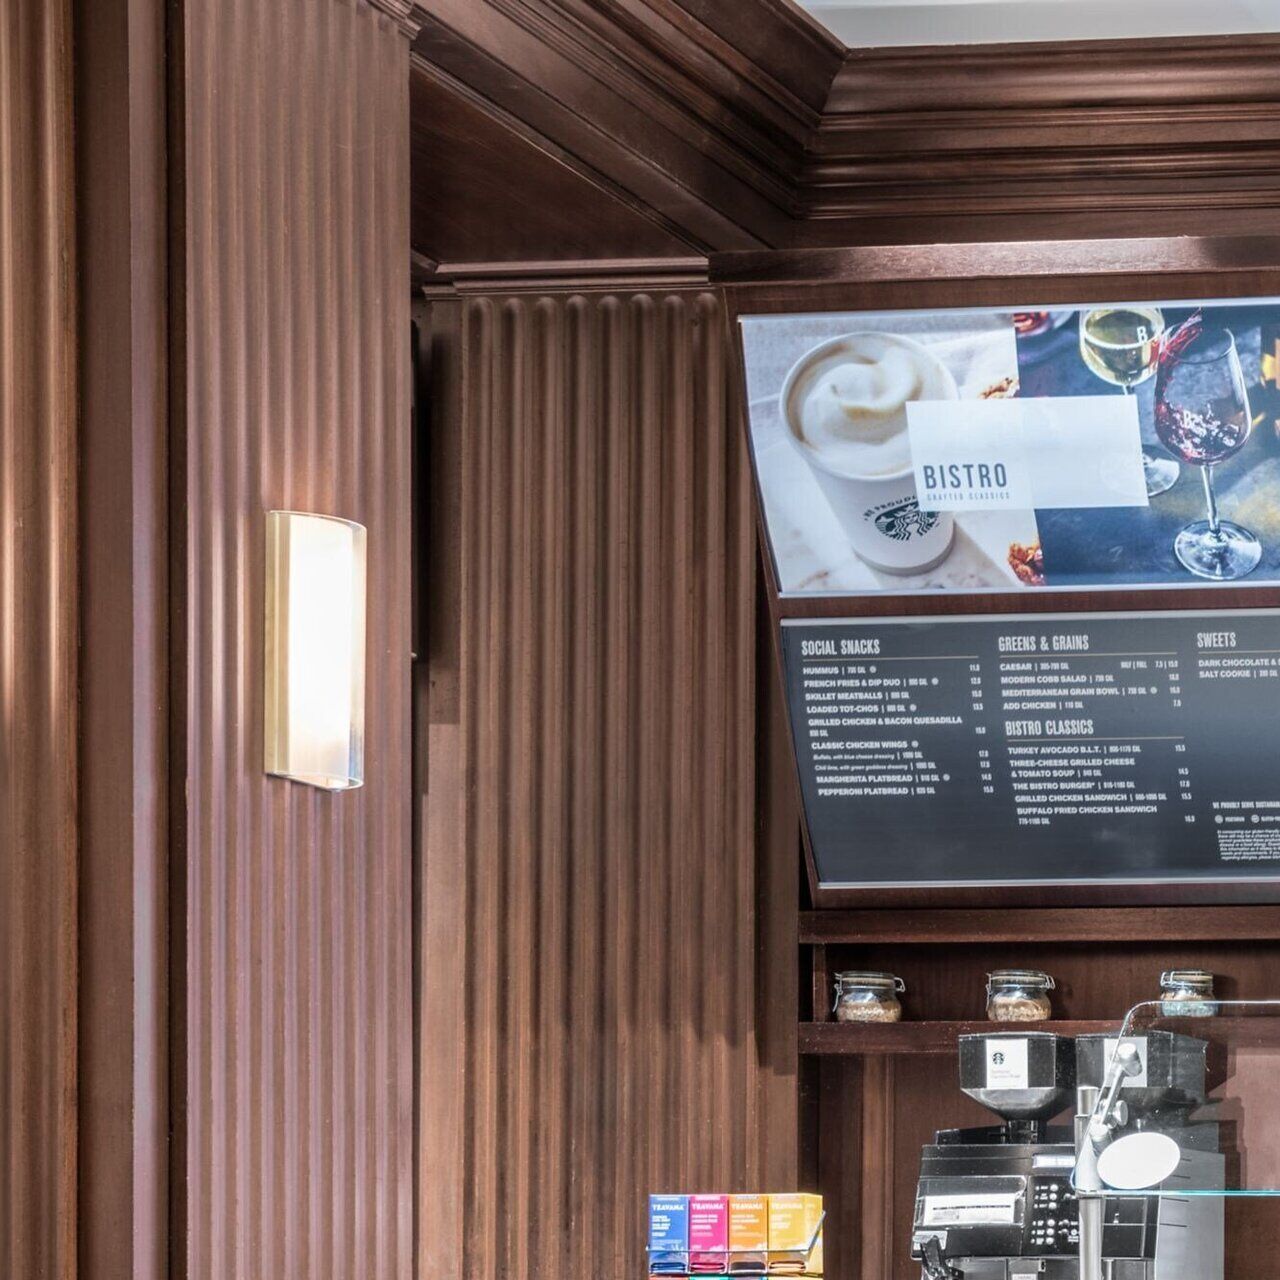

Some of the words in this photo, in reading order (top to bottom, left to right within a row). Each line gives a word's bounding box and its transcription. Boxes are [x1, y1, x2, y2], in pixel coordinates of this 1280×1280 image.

[923, 463, 1007, 489] BISTRO
[927, 493, 964, 501] CRAFTED
[969, 492, 1010, 500] CLASSICS
[998, 636, 1036, 652] GREENS
[1040, 636, 1049, 651] &
[1052, 635, 1089, 650] GRAINS
[1197, 632, 1236, 648] SWEETS
[802, 640, 837, 655] SOCIAL
[841, 639, 880, 655] SNACKS
[1000, 663, 1032, 671] CAESAR
[1222, 658, 1270, 667] CHOCOLATE
[803, 667, 839, 675] HUMMUS
[1220, 670, 1251, 678] COOKIE
[804, 680, 836, 688] FRENCH
[837, 679, 860, 687] FRIES
[1001, 676, 1036, 684] MODERN
[1060, 675, 1087, 683] SALAD
[837, 692, 883, 700] MEATBALLS
[1002, 688, 1069, 697] MEDITERRANEAN
[1096, 687, 1120, 695] BOWL
[1003, 702, 1020, 710] ADD
[808, 718, 841, 726] GRILLED
[842, 718, 876, 726] CHICKEN
[884, 717, 912, 725] BACON
[913, 716, 963, 724] QUESADILLA
[1005, 720, 1042, 736] BISTRO
[1045, 719, 1094, 735] CLASSICS
[811, 742, 845, 750] CLASSIC
[845, 741, 880, 749] CHICKEN
[1040, 746, 1079, 754] AVOCADO
[1104, 758, 1135, 766] CHEESE
[1018, 770, 1051, 778] TOMATO
[816, 775, 867, 783] MARGHERITA
[1029, 782, 1059, 790] BISTRO
[818, 788, 863, 796] PEPPERONI
[864, 787, 909, 795] FLATBREAD
[1048, 794, 1083, 802] CHICKEN
[1017, 807, 1053, 815] BUFFALO
[1079, 806, 1113, 814] CHICKEN
